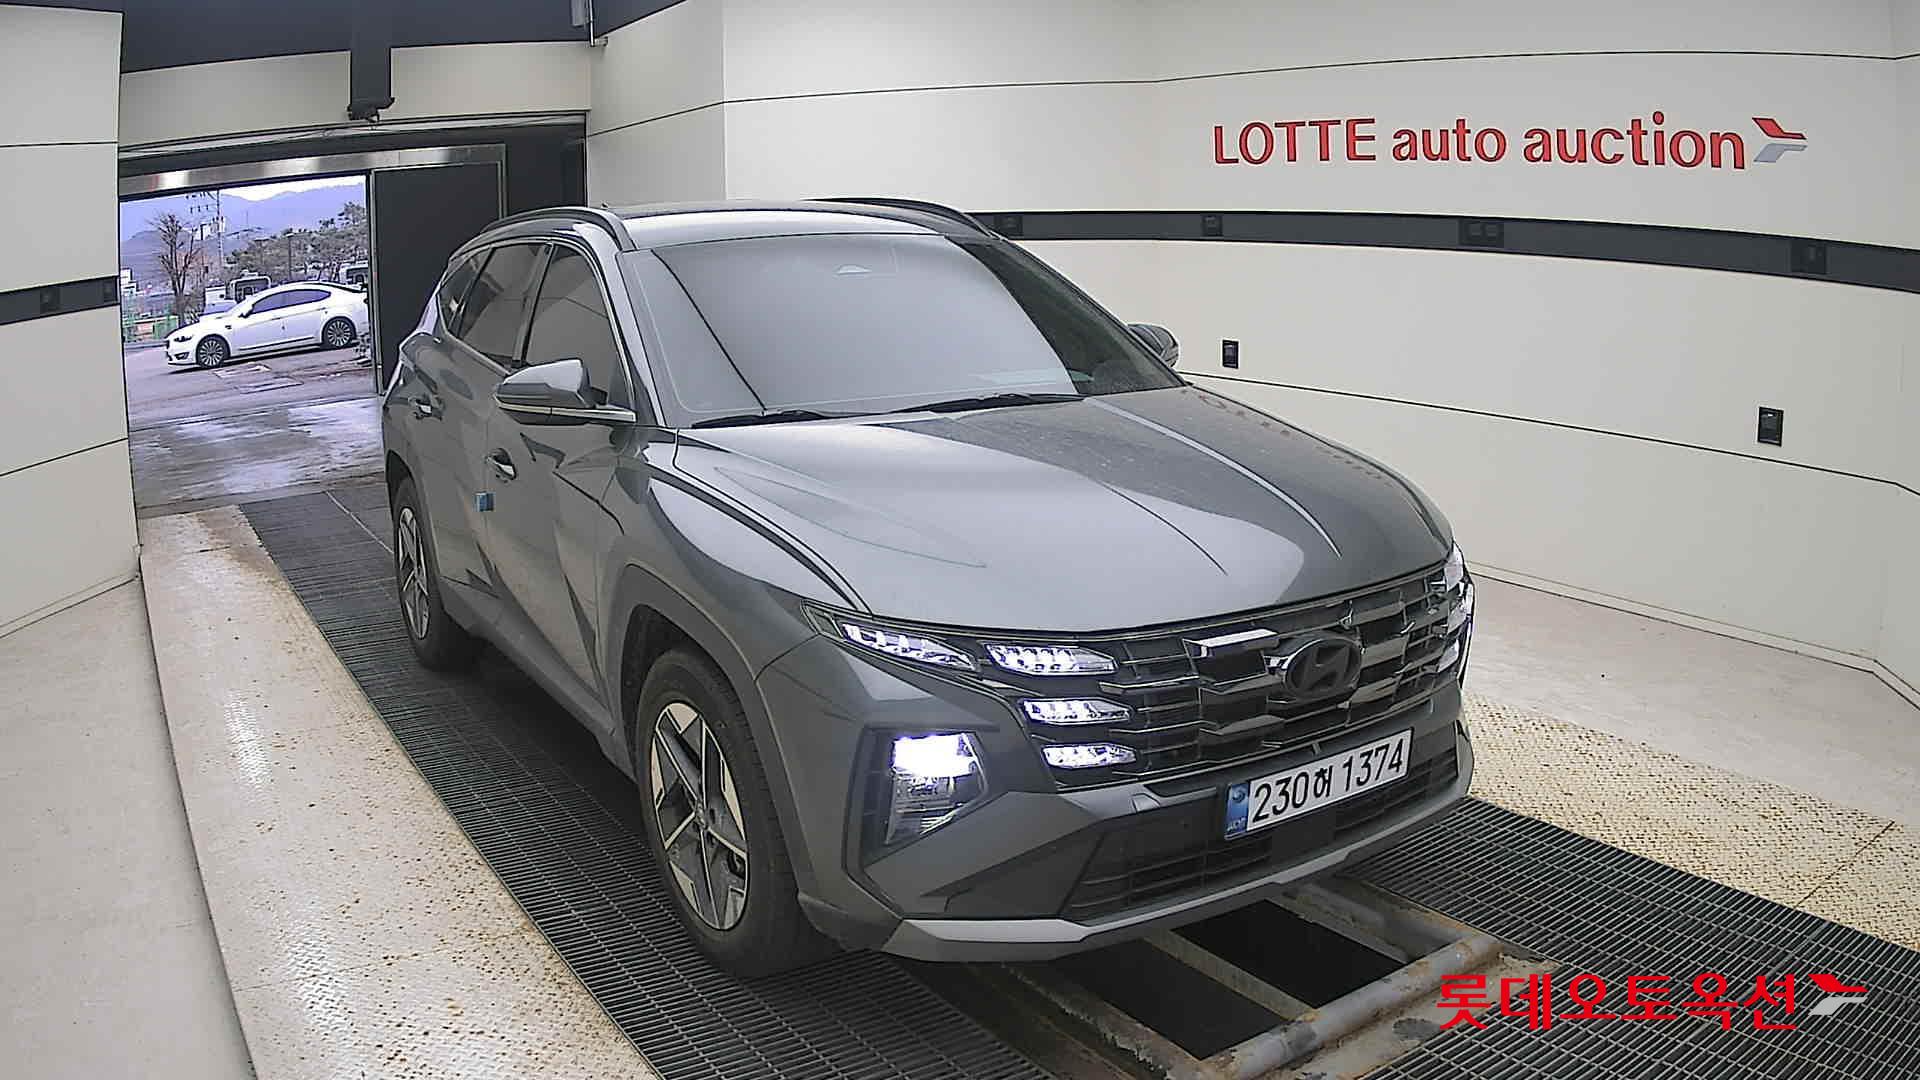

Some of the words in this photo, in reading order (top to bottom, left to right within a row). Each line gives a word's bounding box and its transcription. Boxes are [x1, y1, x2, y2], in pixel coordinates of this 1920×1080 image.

[1213, 118, 1376, 164] LOTTE
[1392, 118, 1507, 162] auto
[1523, 111, 1746, 170] auction
[1253, 766, 1334, 823] 230허
[1342, 738, 1404, 792] 1374
